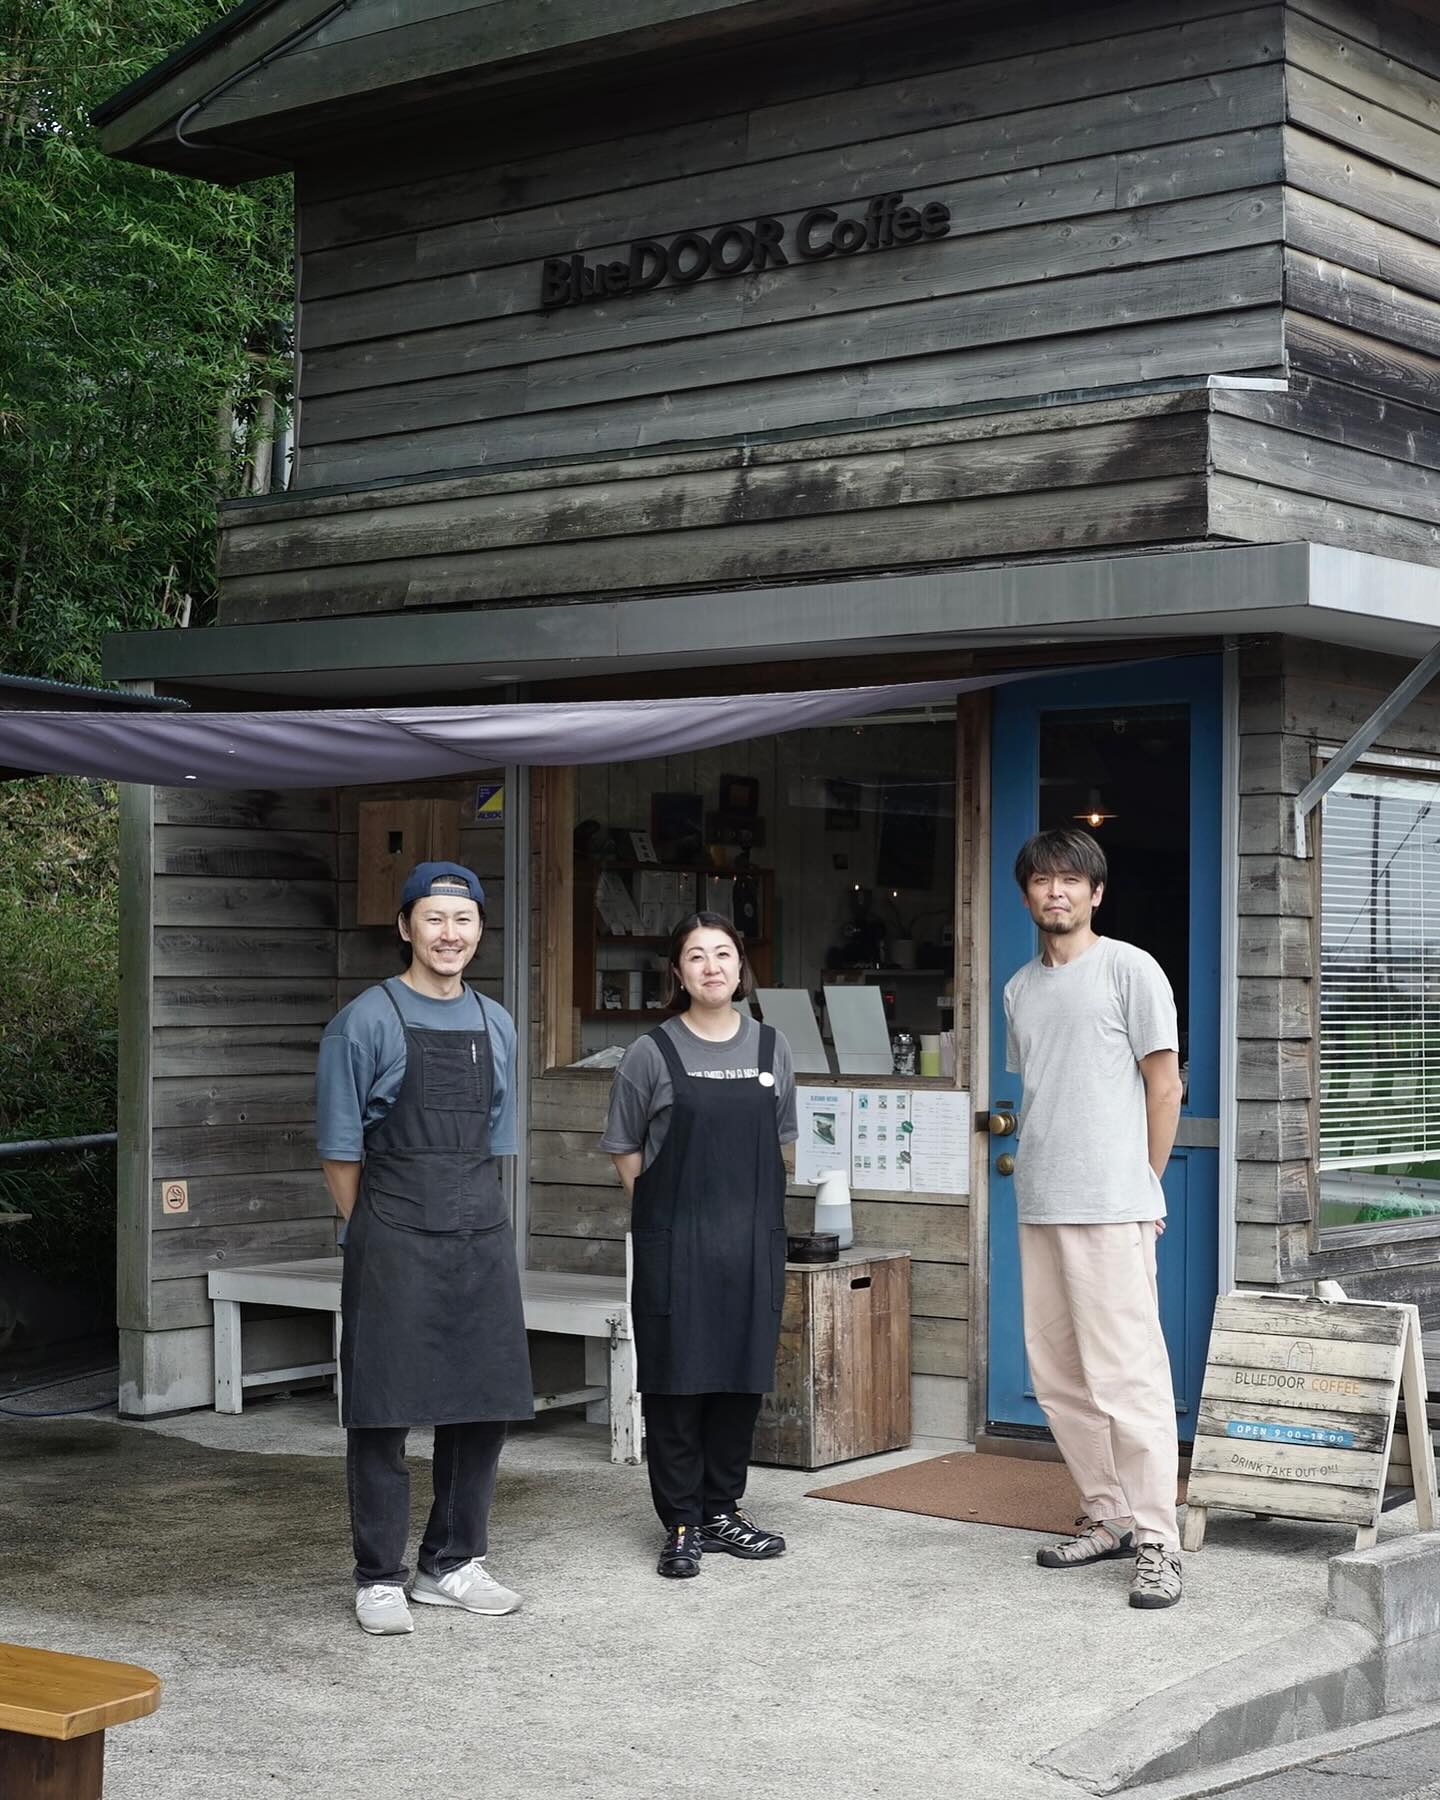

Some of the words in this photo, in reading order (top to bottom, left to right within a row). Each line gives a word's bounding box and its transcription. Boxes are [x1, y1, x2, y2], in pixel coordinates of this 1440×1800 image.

[543, 217, 789, 306] BlueDOOR
[799, 192, 951, 259] Coffee
[1234, 1371, 1305, 1389] BLUEDOOR
[1311, 1378, 1360, 1395] COFFEE
[1236, 1424, 1267, 1436] OPEN
[1231, 1454, 1263, 1473] DRINK
[1266, 1465, 1293, 1478] TAKE
[1295, 1467, 1317, 1478] OUT
